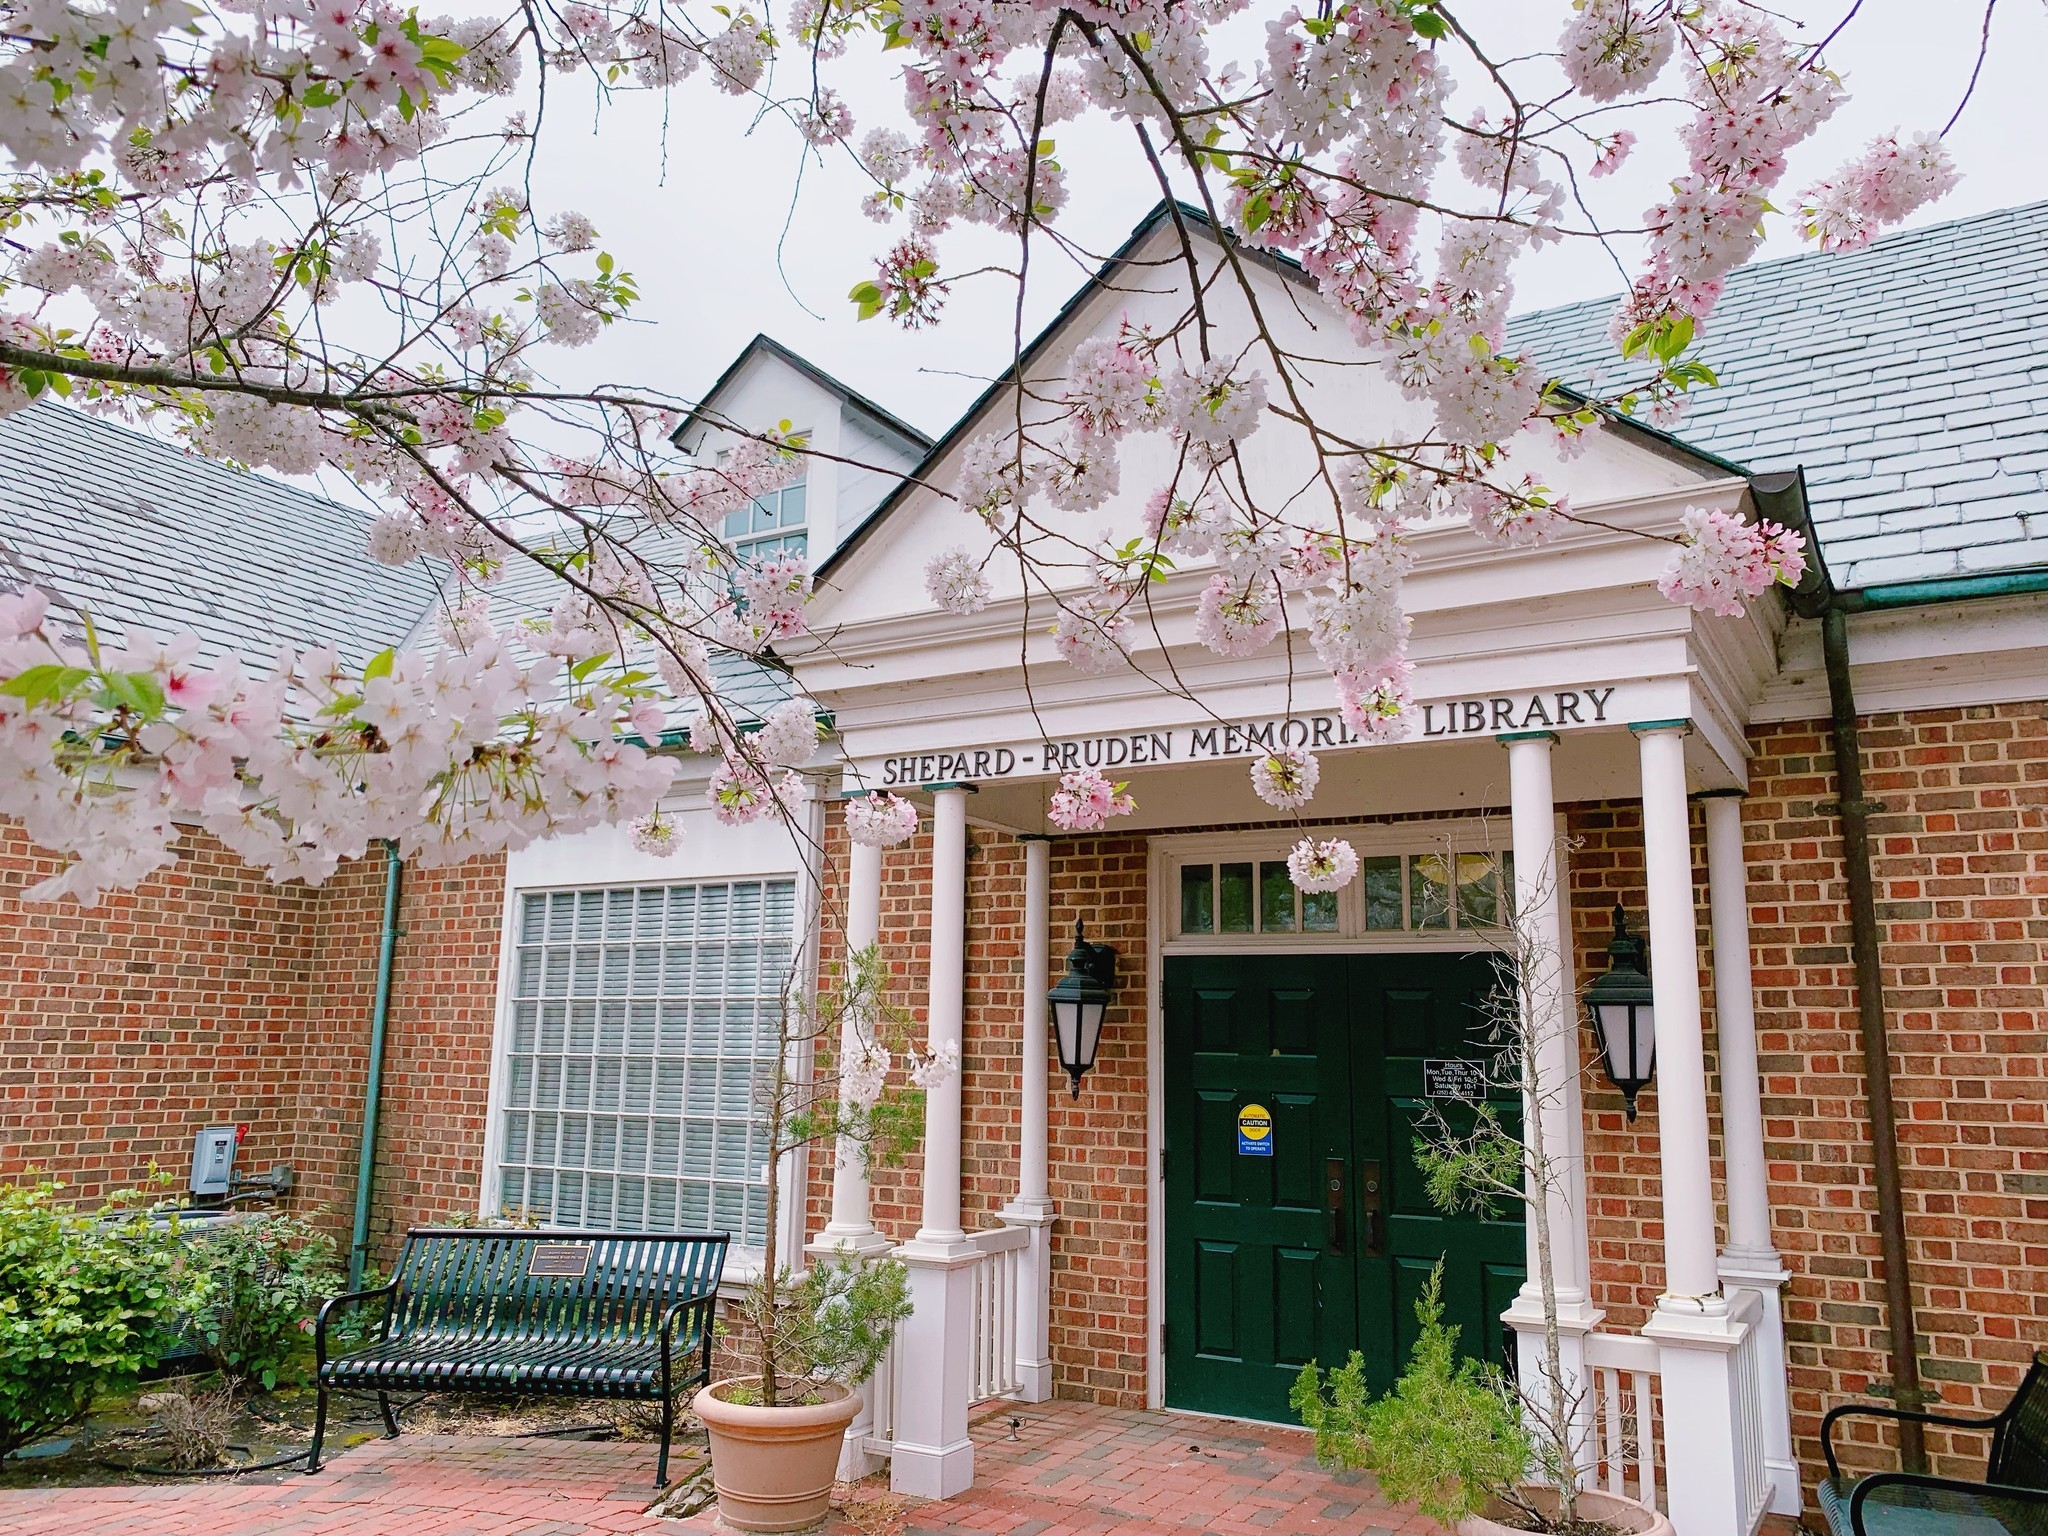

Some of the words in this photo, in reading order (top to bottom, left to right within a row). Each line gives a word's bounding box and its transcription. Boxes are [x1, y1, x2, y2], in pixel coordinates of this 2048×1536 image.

[1188, 706, 1384, 758] MEMORI
[1422, 687, 1616, 737] LIBRARY
[1434, 1082, 1462, 1090] Saturay
